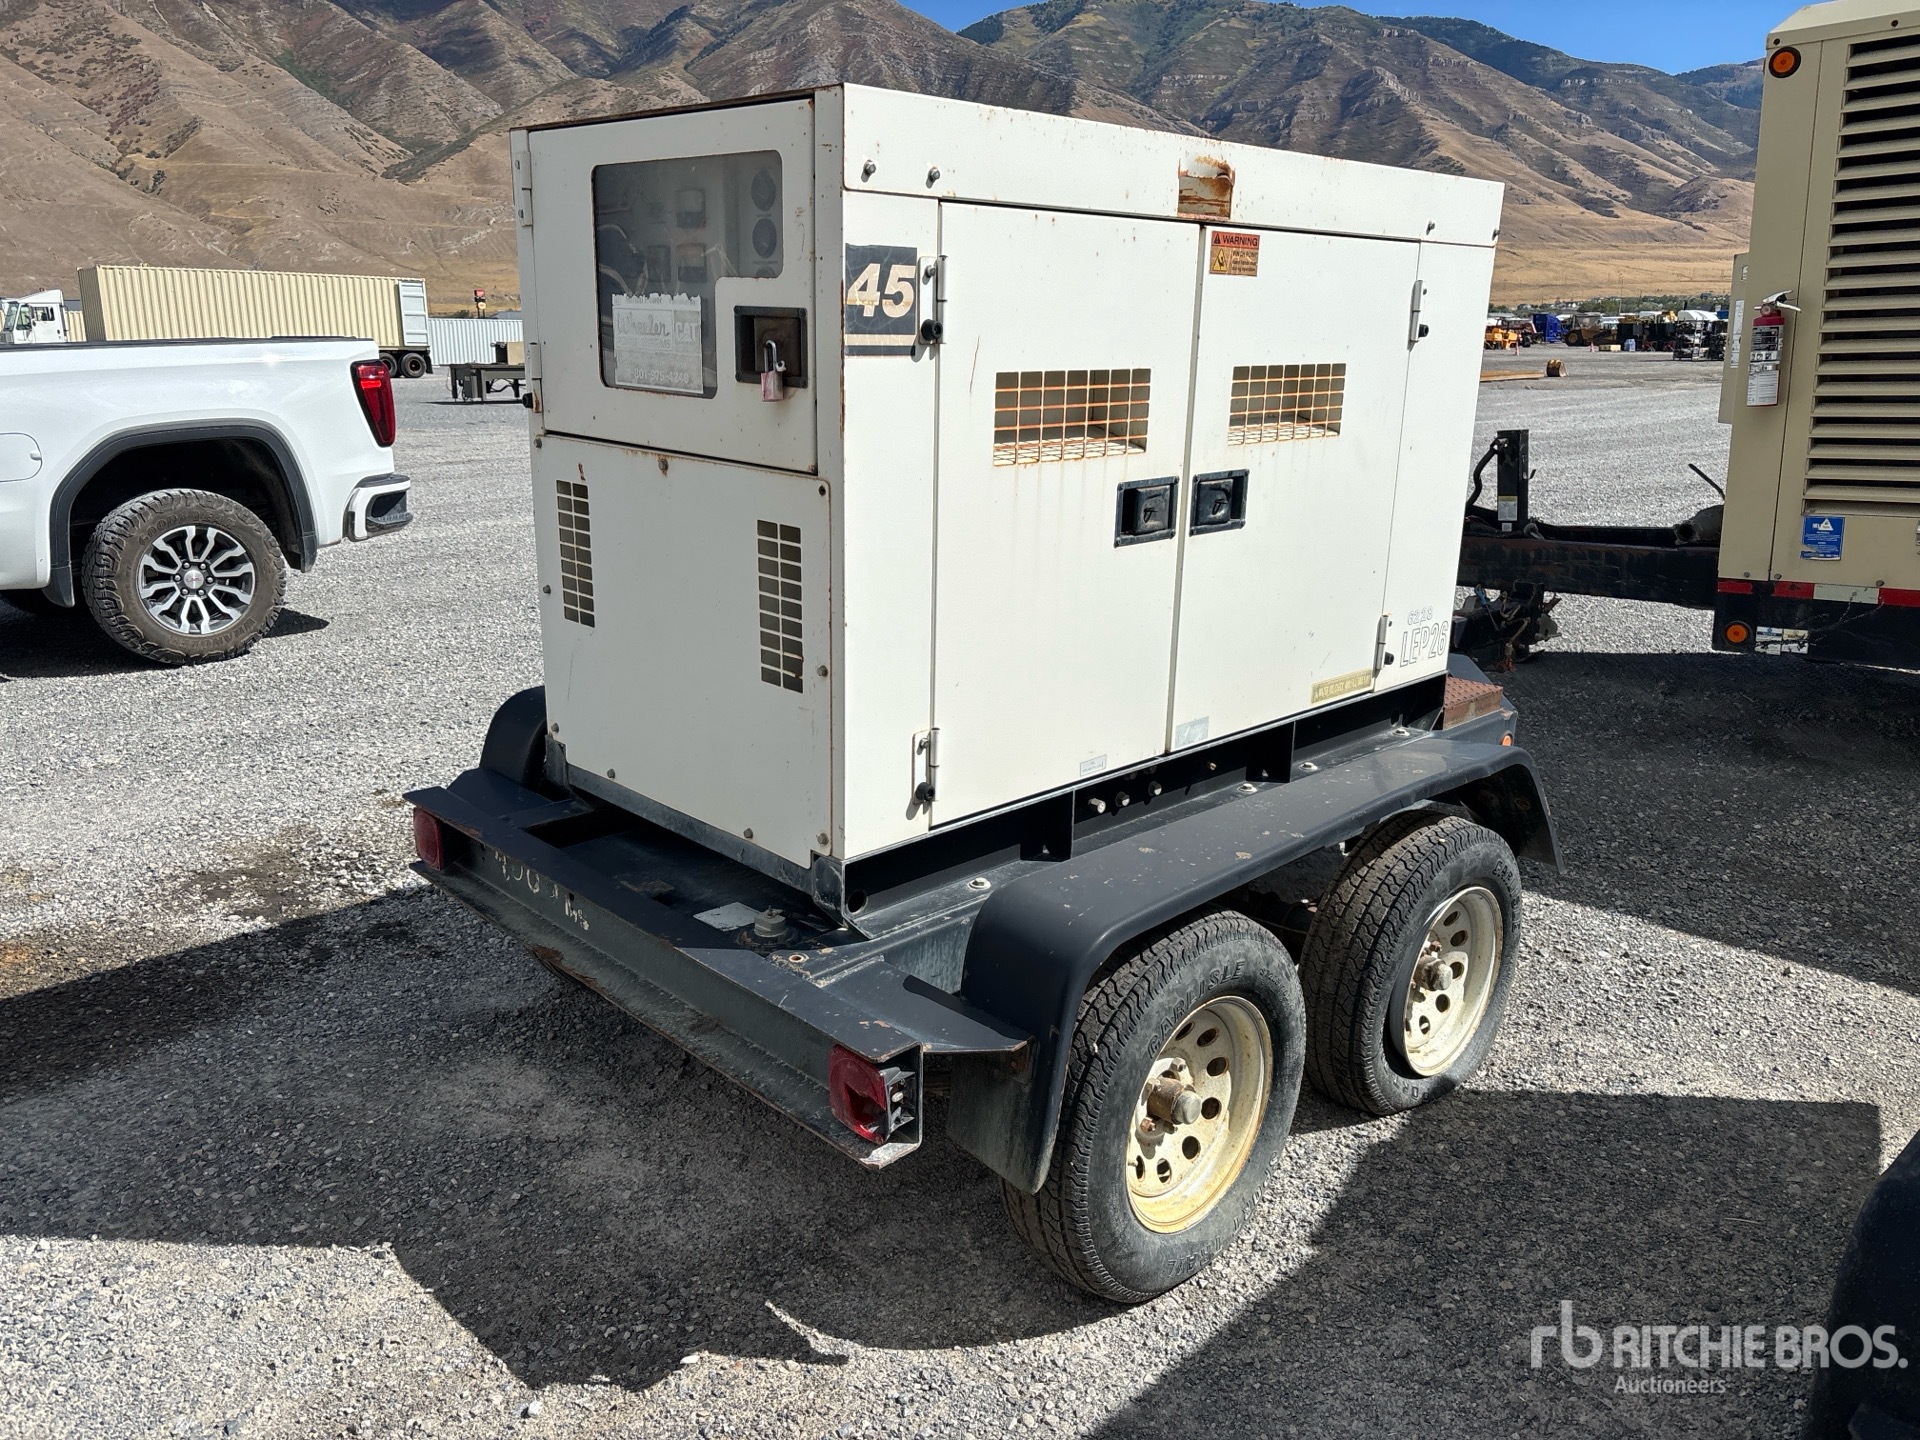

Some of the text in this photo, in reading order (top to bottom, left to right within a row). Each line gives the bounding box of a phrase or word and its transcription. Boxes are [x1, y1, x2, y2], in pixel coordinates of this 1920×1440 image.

[1222, 234, 1258, 247] WARNING
[847, 263, 916, 318] 45
[675, 322, 698, 343] CAT
[1399, 620, 1449, 668] LEP26
[1147, 959, 1246, 1059] CARLISLE
